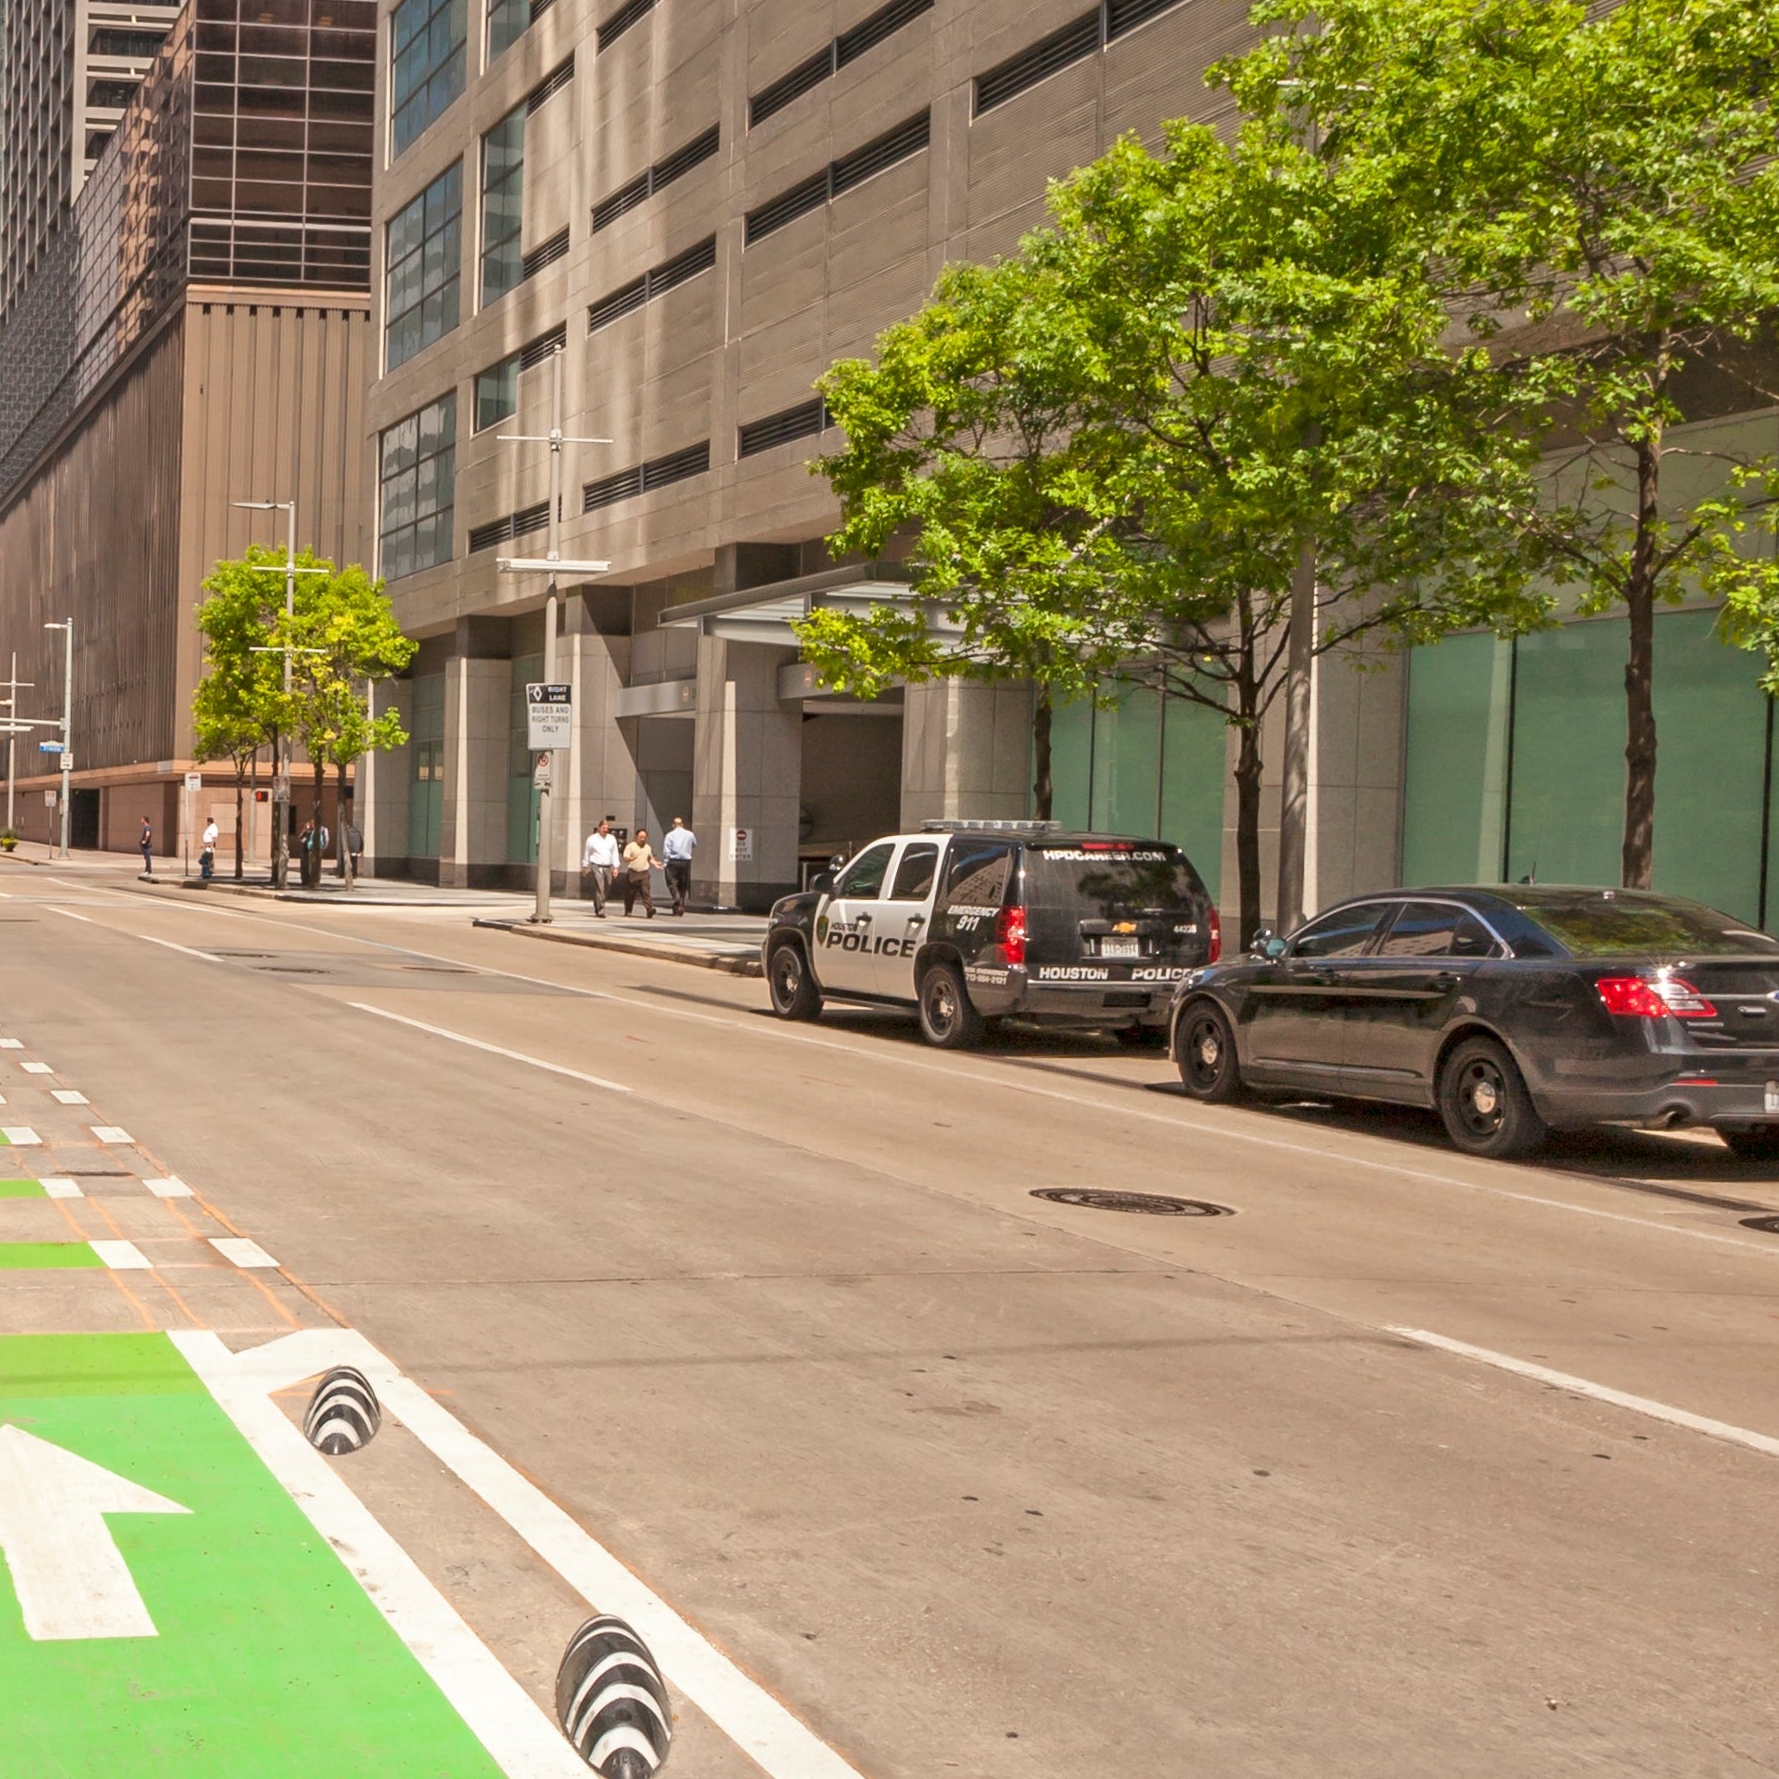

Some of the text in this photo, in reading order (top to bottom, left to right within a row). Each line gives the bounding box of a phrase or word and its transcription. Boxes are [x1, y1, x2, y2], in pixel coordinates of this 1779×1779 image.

[532, 705, 570, 714] BUSES AND
[532, 715, 569, 723] RIGHT TURNS
[541, 725, 560, 733] ONLY
[1042, 849, 1167, 862] HPDCAREER.COM
[947, 904, 1001, 918] EMERGENCY
[830, 921, 858, 933] HOUSTON
[956, 915, 981, 932] 911
[826, 931, 917, 958] POLICE
[1039, 966, 1110, 980] HOUSTON
